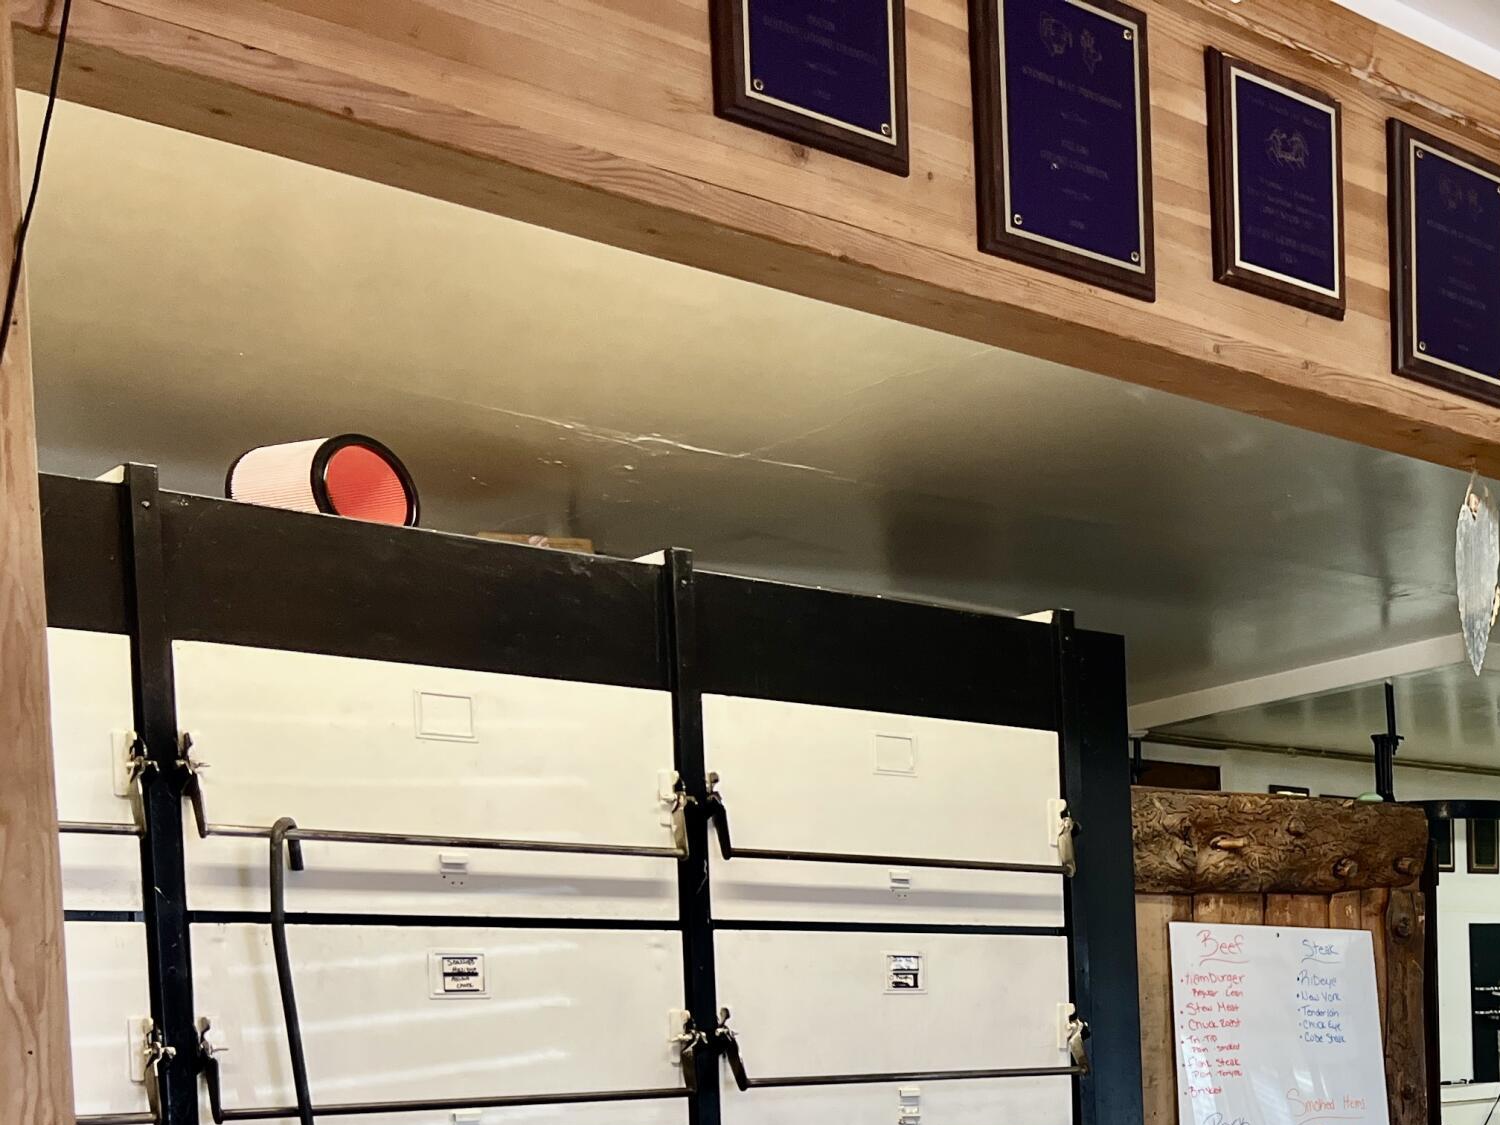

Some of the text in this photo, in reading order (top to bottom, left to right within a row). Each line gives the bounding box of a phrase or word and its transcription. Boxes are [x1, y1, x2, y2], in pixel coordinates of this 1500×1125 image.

[1197, 929, 1244, 957] Beef
[1302, 939, 1340, 957] Steak
[1185, 972, 1246, 986] Hamburger
[1299, 969, 1337, 988] Ribeye
[1301, 992, 1342, 1001] New York
[1186, 1003, 1240, 1015] Stew Meat
[1189, 1019, 1219, 1031] Chuck
[1327, 1020, 1342, 1032] Eye
[1216, 1058, 1241, 1067] Steak
